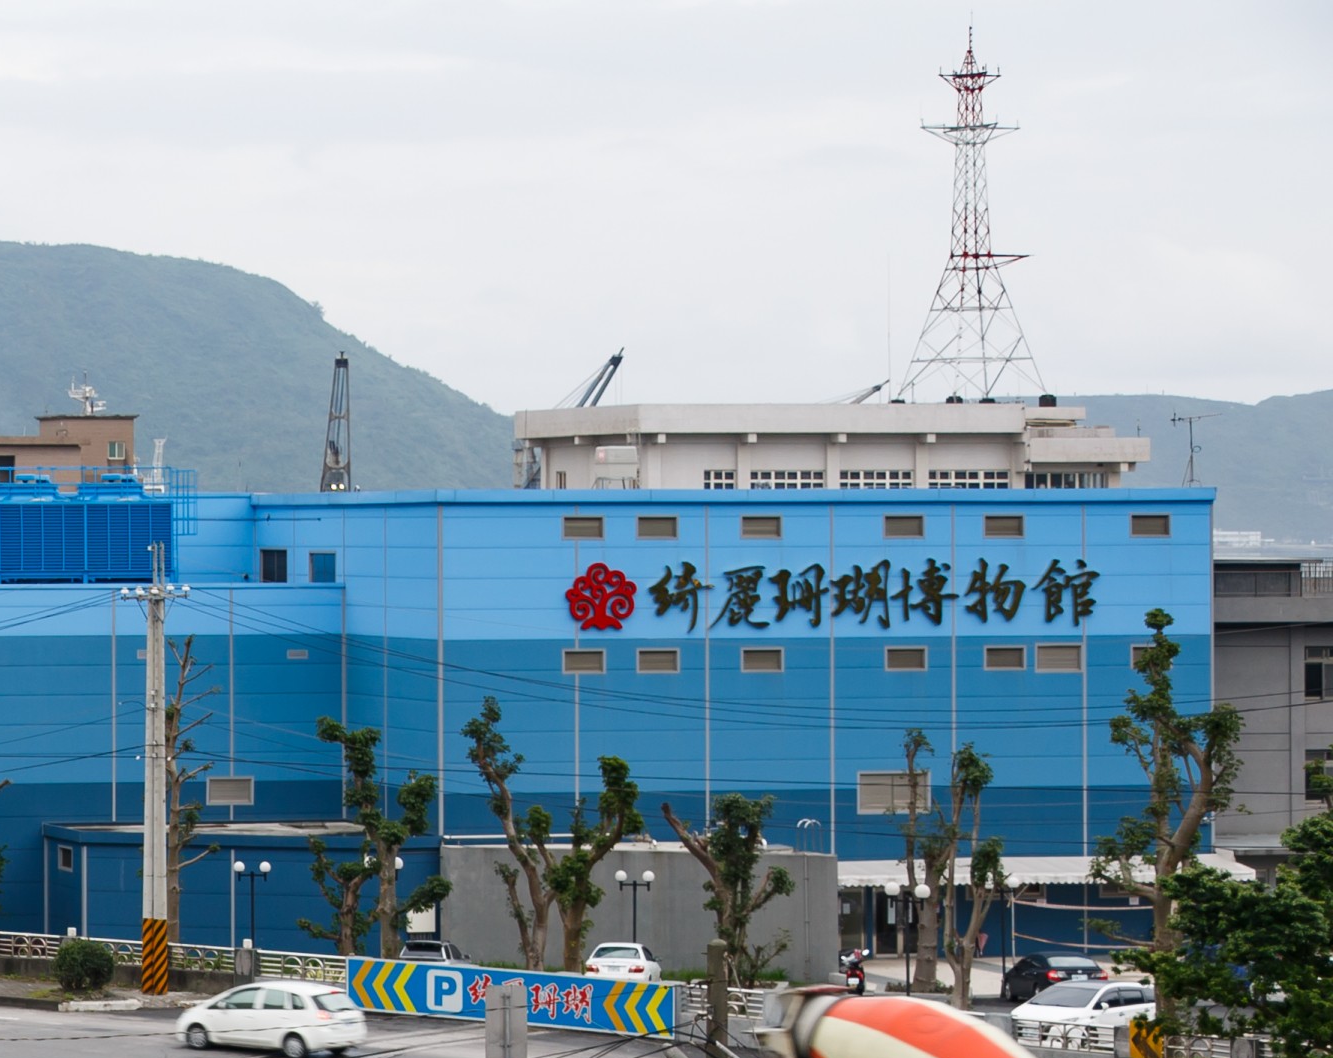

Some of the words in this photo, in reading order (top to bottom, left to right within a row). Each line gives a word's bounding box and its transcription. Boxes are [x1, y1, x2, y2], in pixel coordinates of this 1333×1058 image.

[648, 558, 1100, 633] 綺麗珊瑚博物館
[433, 976, 457, 1006] P
